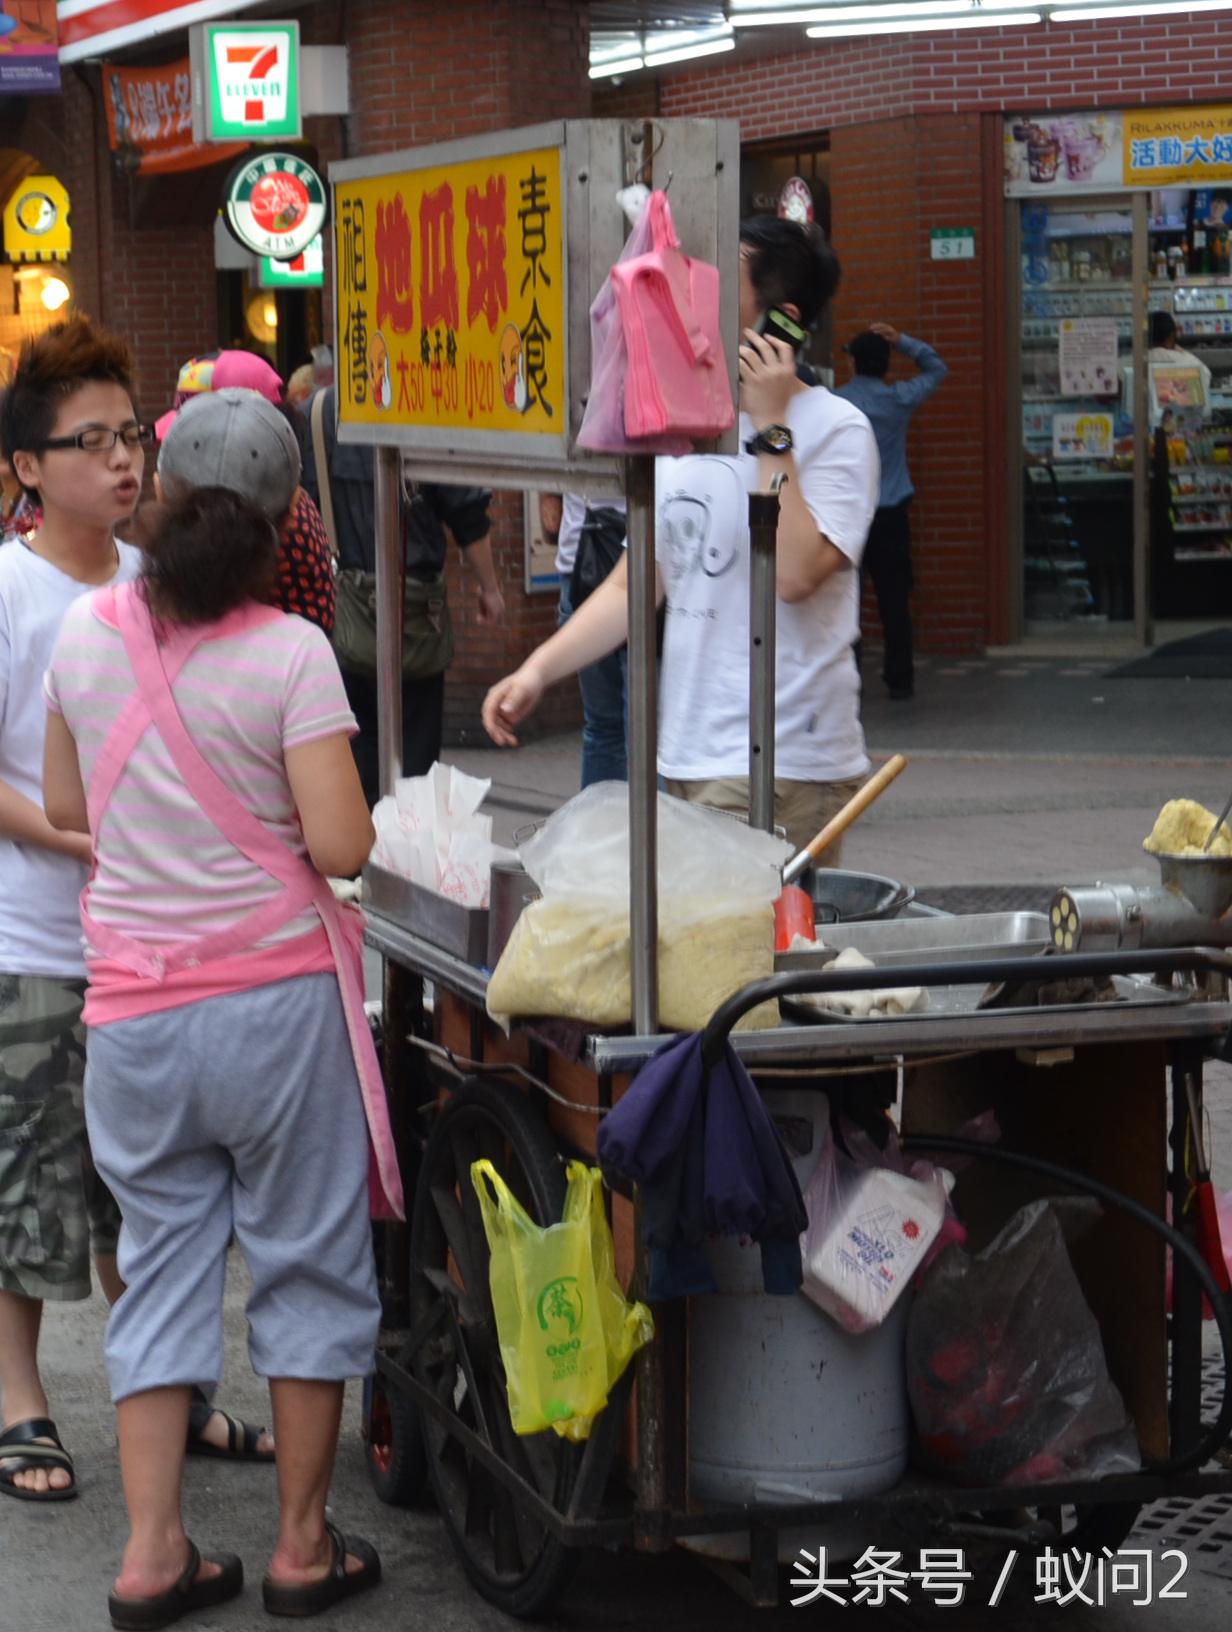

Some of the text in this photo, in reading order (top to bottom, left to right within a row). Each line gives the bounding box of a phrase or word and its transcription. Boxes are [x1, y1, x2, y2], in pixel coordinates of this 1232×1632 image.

[264, 236, 296, 249] ATM
[375, 173, 509, 336] 地瓜球
[939, 241, 964, 256] 51
[517, 164, 554, 418] 素食
